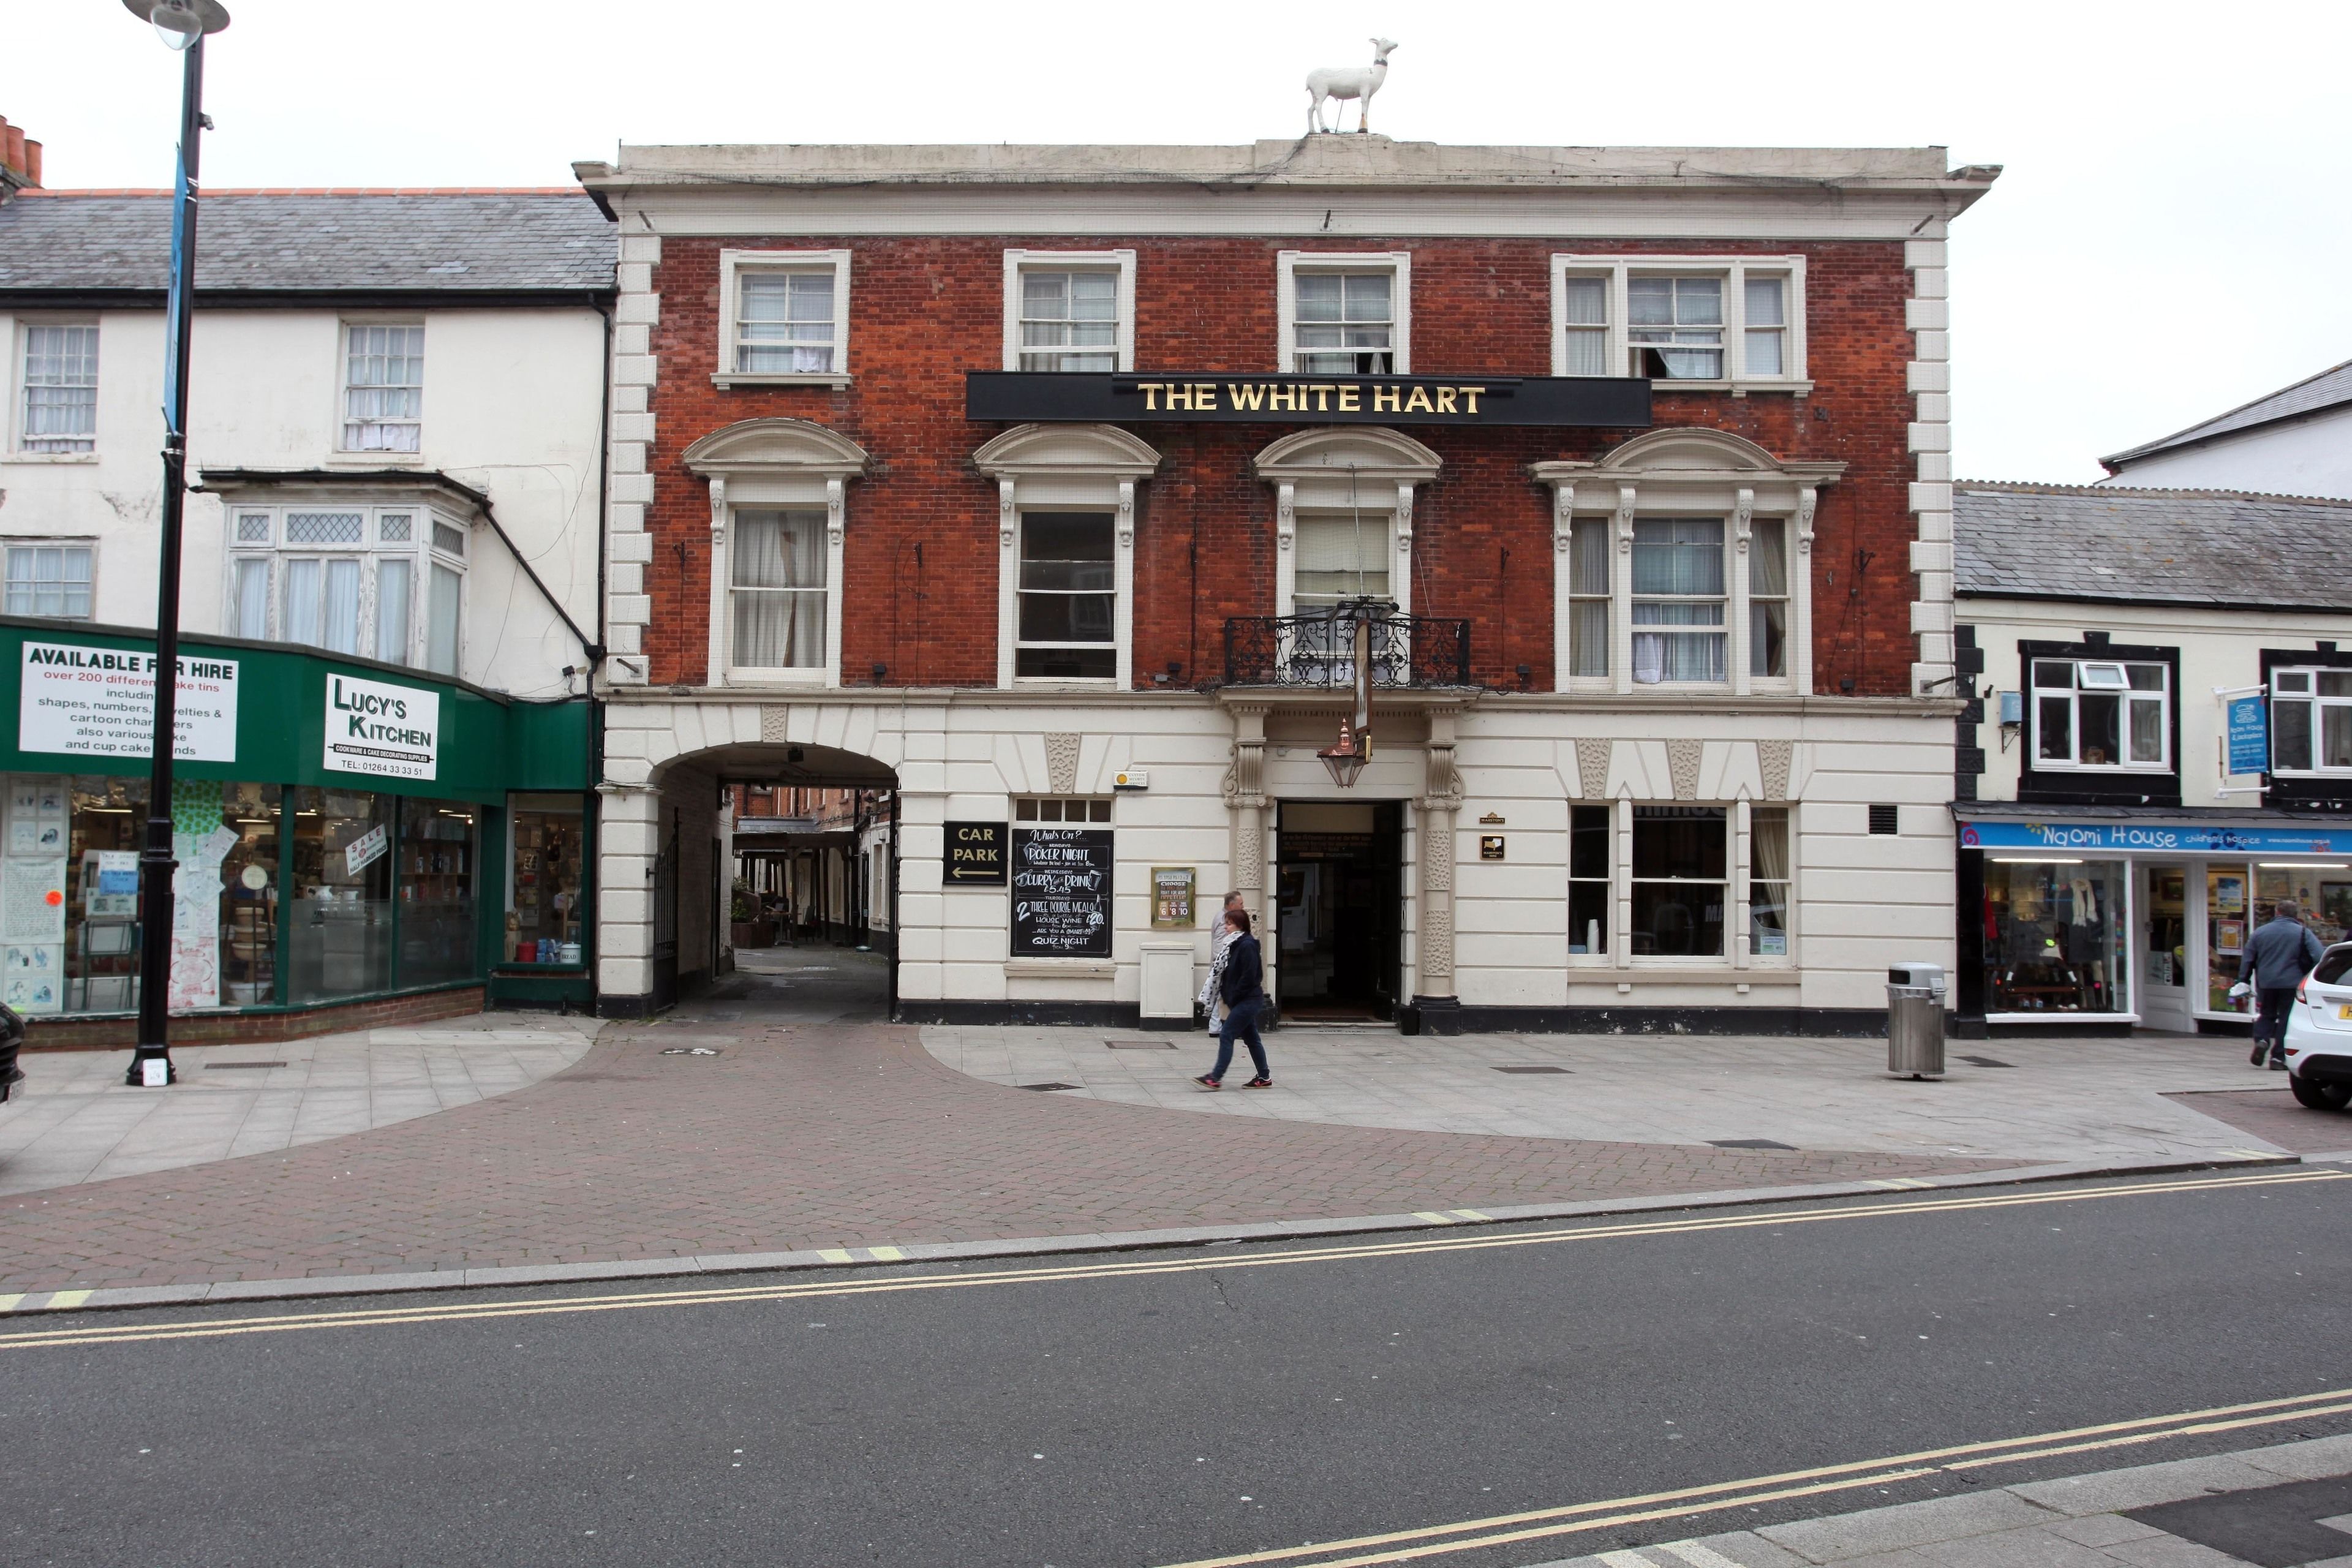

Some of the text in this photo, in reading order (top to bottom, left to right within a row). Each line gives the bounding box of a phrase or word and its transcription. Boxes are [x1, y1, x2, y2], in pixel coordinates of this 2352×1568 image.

[1137, 383, 1485, 413] THE WHITE HART
[29, 648, 233, 680] AVAILABLE FR HIRE
[78, 673, 102, 682] 200
[106, 674, 157, 687] differen
[175, 680, 194, 690] ake
[198, 682, 219, 692] tins
[107, 689, 154, 700] includin
[334, 679, 407, 719] LUCY'S
[39, 697, 89, 710] shapes,
[94, 700, 152, 714] numbers,
[214, 709, 222, 718] &
[70, 715, 192, 729] cartoon charers
[77, 727, 103, 737] also
[108, 729, 154, 740] various
[349, 715, 431, 747] KITCHEN
[66, 740, 89, 750] and
[93, 742, 116, 752] cup
[121, 742, 151, 753] cake
[336, 745, 363, 755] COOKWARE
[380, 751, 407, 760] DECORATING
[342, 760, 360, 769] TEL:
[363, 763, 387, 772] 01264
[390, 765, 399, 774] 33
[352, 827, 381, 853] SALE
[959, 828, 994, 841] CAR
[2043, 826, 2101, 846] Naomi
[2111, 825, 2178, 847] House
[2184, 833, 2224, 844] children's
[2226, 835, 2261, 846] hospice
[953, 849, 998, 861] PARK
[1028, 848, 1090, 861] POKER NIGHT
[1027, 874, 1056, 886] CURRY
[1065, 875, 1091, 887] DRINK
[1017, 901, 1095, 922] 2 THREE COURSE MEALS
